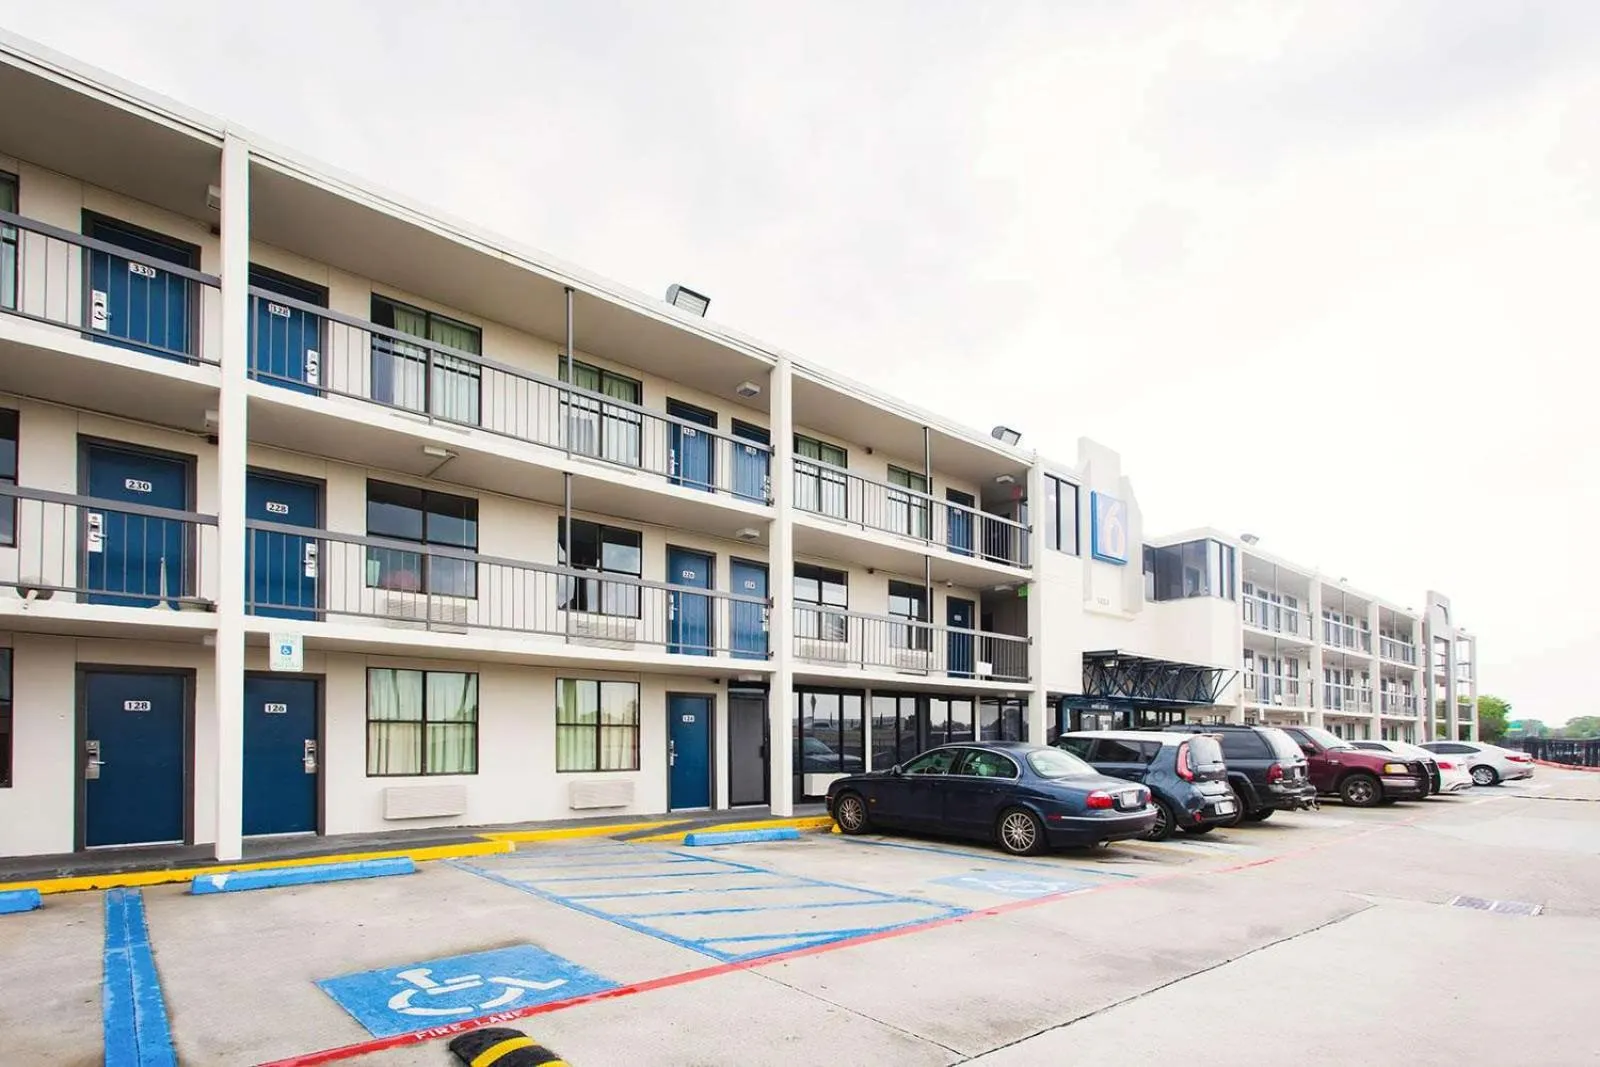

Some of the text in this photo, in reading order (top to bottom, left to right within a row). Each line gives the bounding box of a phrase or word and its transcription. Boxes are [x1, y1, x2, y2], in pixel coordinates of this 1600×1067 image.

[128, 480, 150, 491] 230
[268, 503, 287, 513] 228
[1103, 500, 1126, 558] 6
[127, 701, 149, 710] 128
[267, 704, 285, 712] 126
[415, 1008, 524, 1040] FIRE LANE
